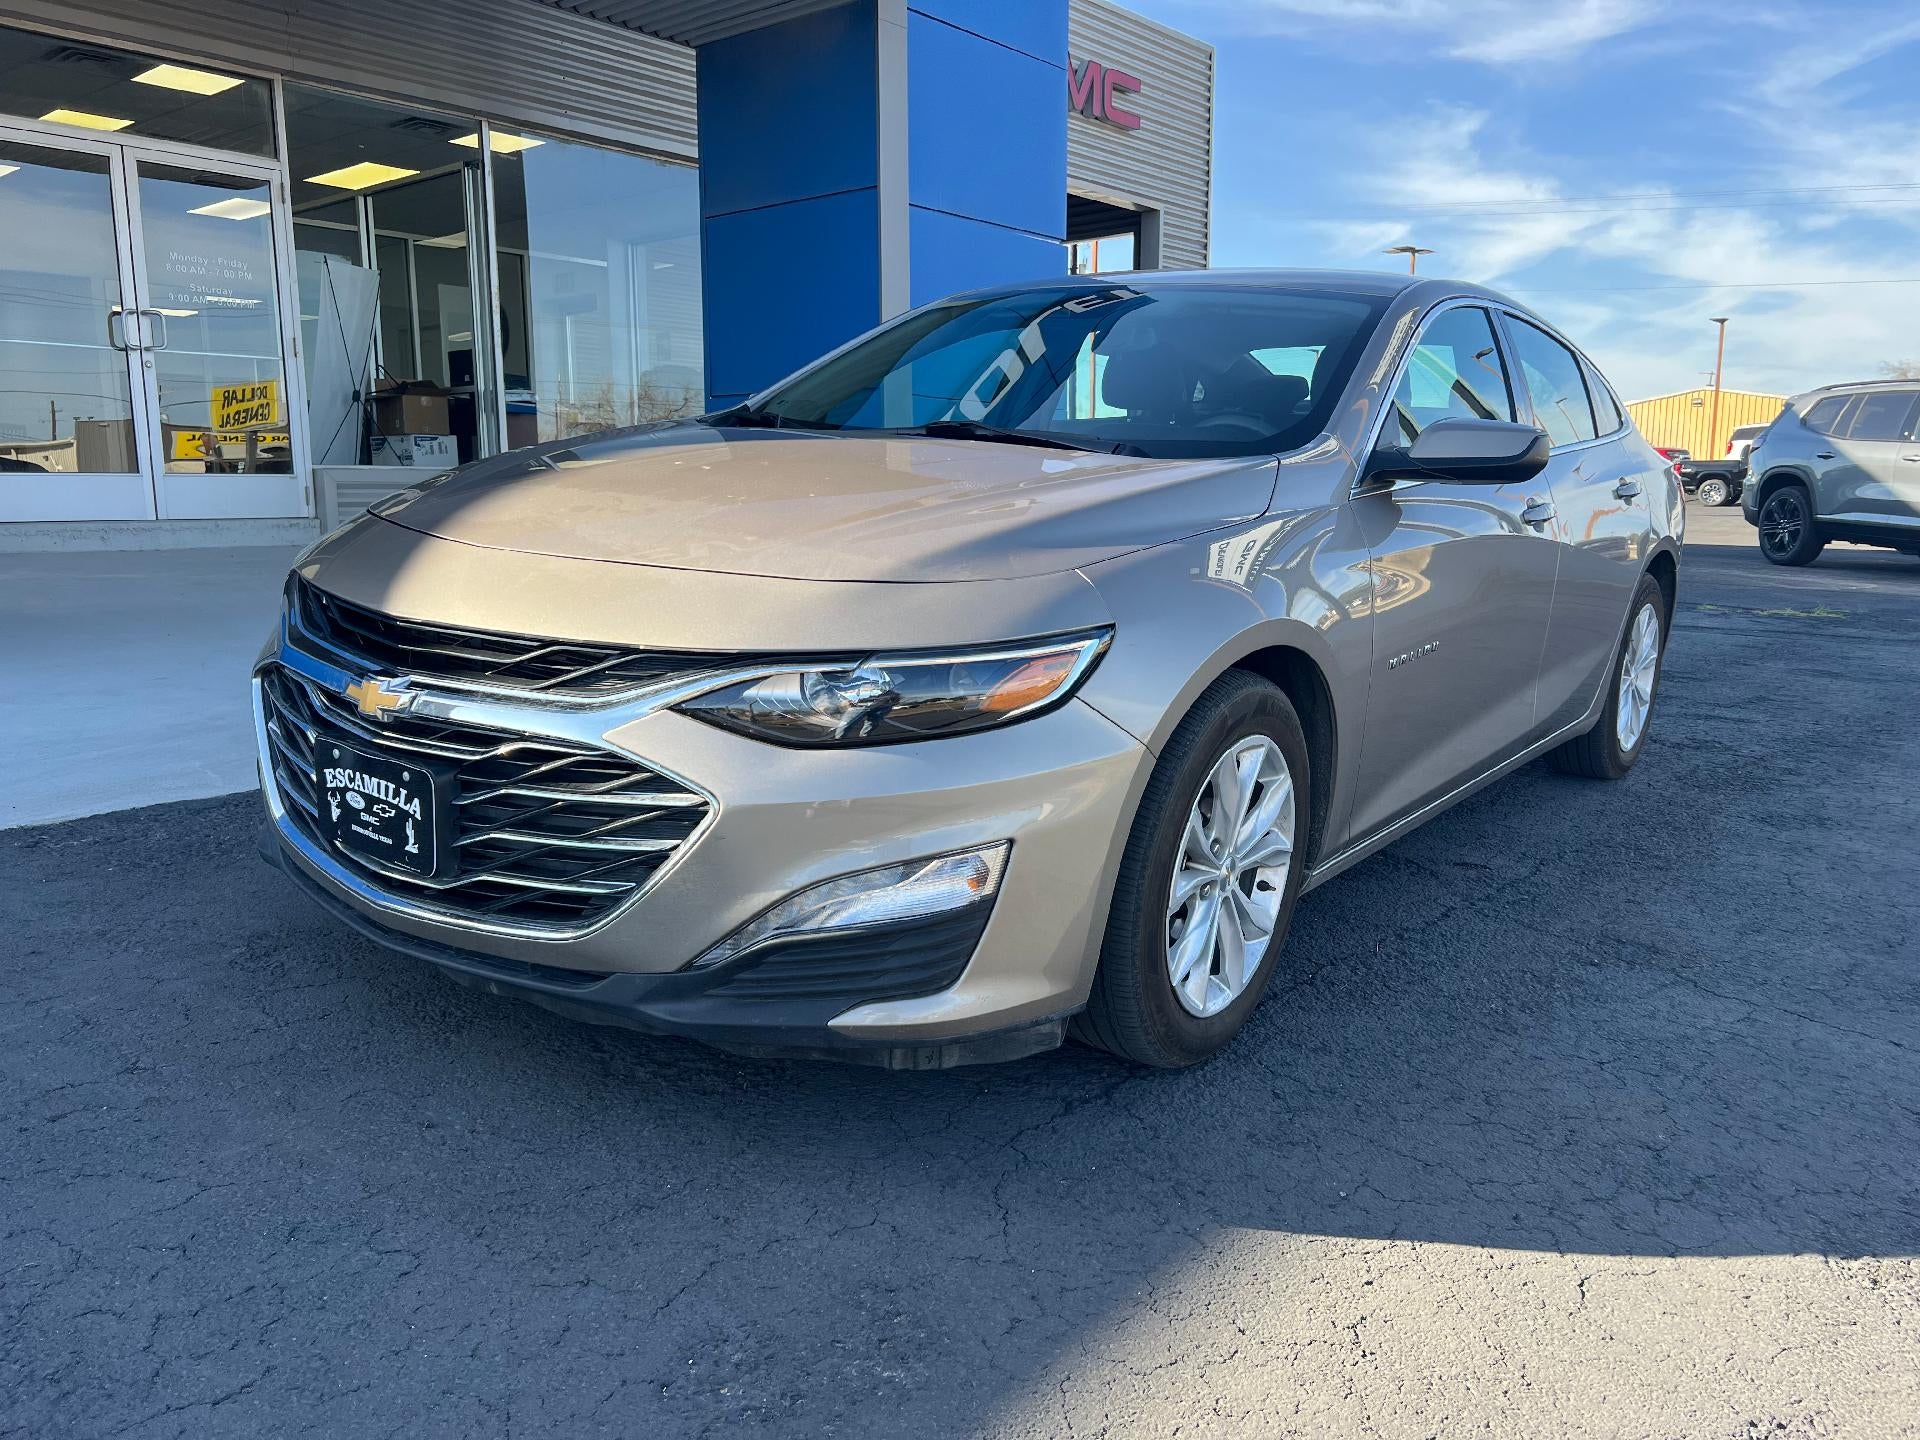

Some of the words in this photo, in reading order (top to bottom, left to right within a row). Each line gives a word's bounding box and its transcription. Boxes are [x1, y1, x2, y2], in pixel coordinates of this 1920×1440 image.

[1068, 51, 1141, 130] MC
[169, 251, 208, 266] Monday
[218, 257, 248, 270] Friday
[190, 265, 206, 275] AM
[189, 283, 234, 297] Saturday
[323, 767, 421, 820] ESCAMILLA
